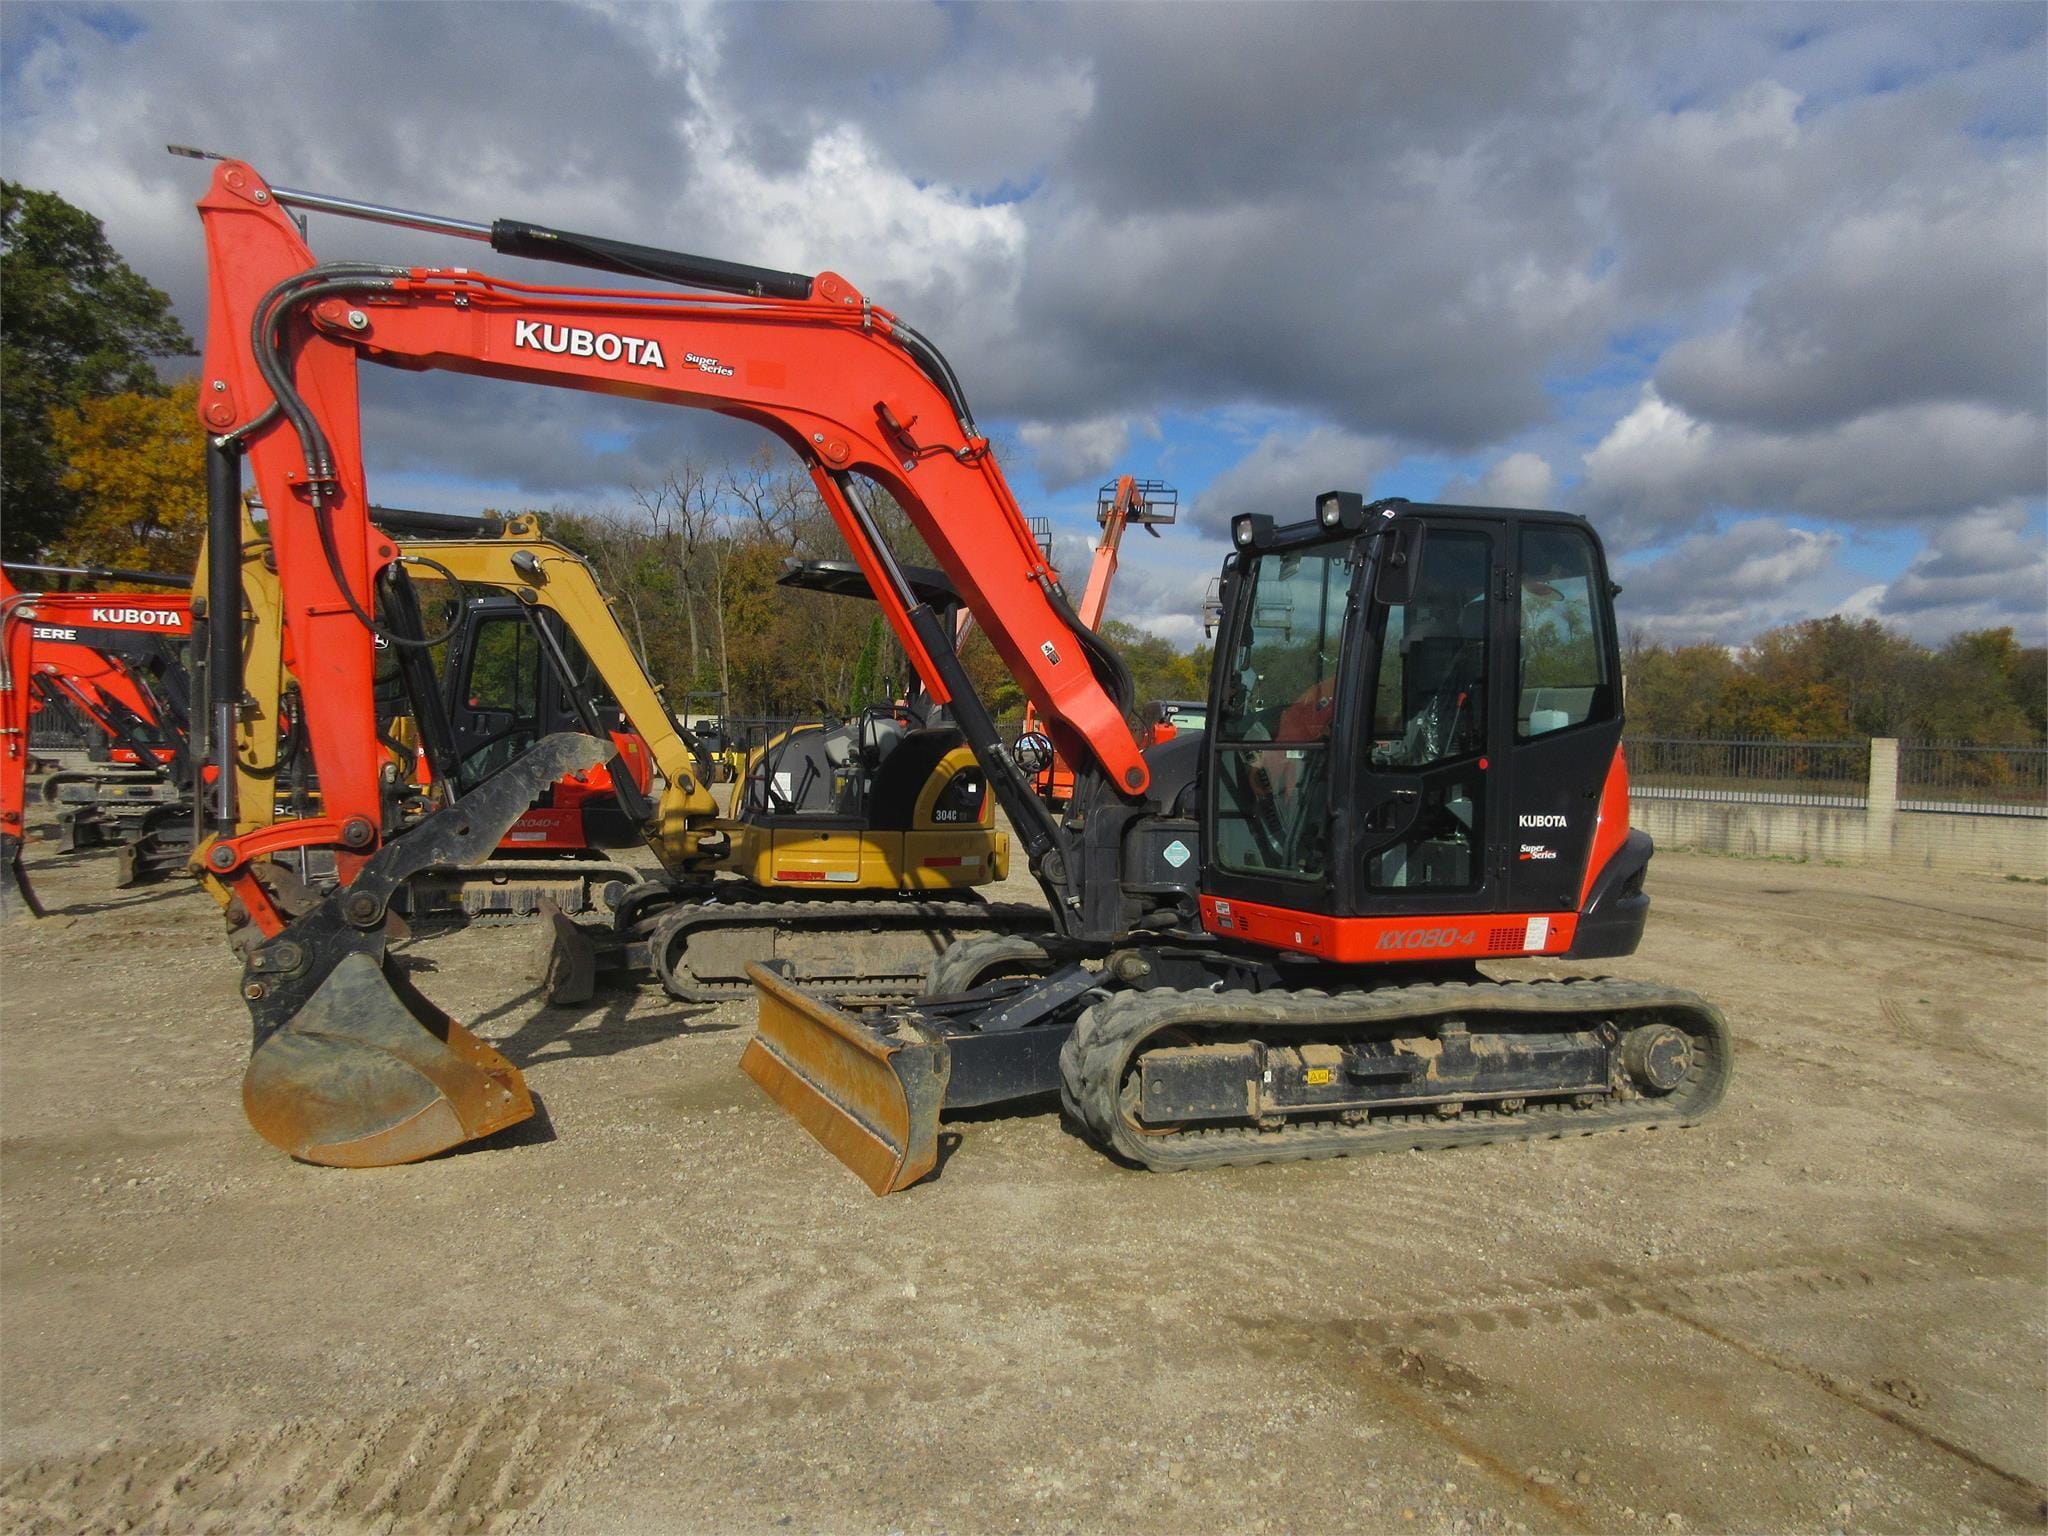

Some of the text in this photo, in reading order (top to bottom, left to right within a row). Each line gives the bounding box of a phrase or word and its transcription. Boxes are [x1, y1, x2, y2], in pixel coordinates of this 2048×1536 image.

[515, 319, 666, 369] KUBOTA
[685, 353, 718, 366] Super
[700, 363, 734, 376] Series
[92, 608, 182, 626] KUBOTA
[935, 810, 957, 821] 304C
[1519, 815, 1567, 828] KUBOTA
[1520, 844, 1545, 854] Super
[1531, 851, 1557, 860] Series
[1376, 927, 1477, 950] KX080-4
